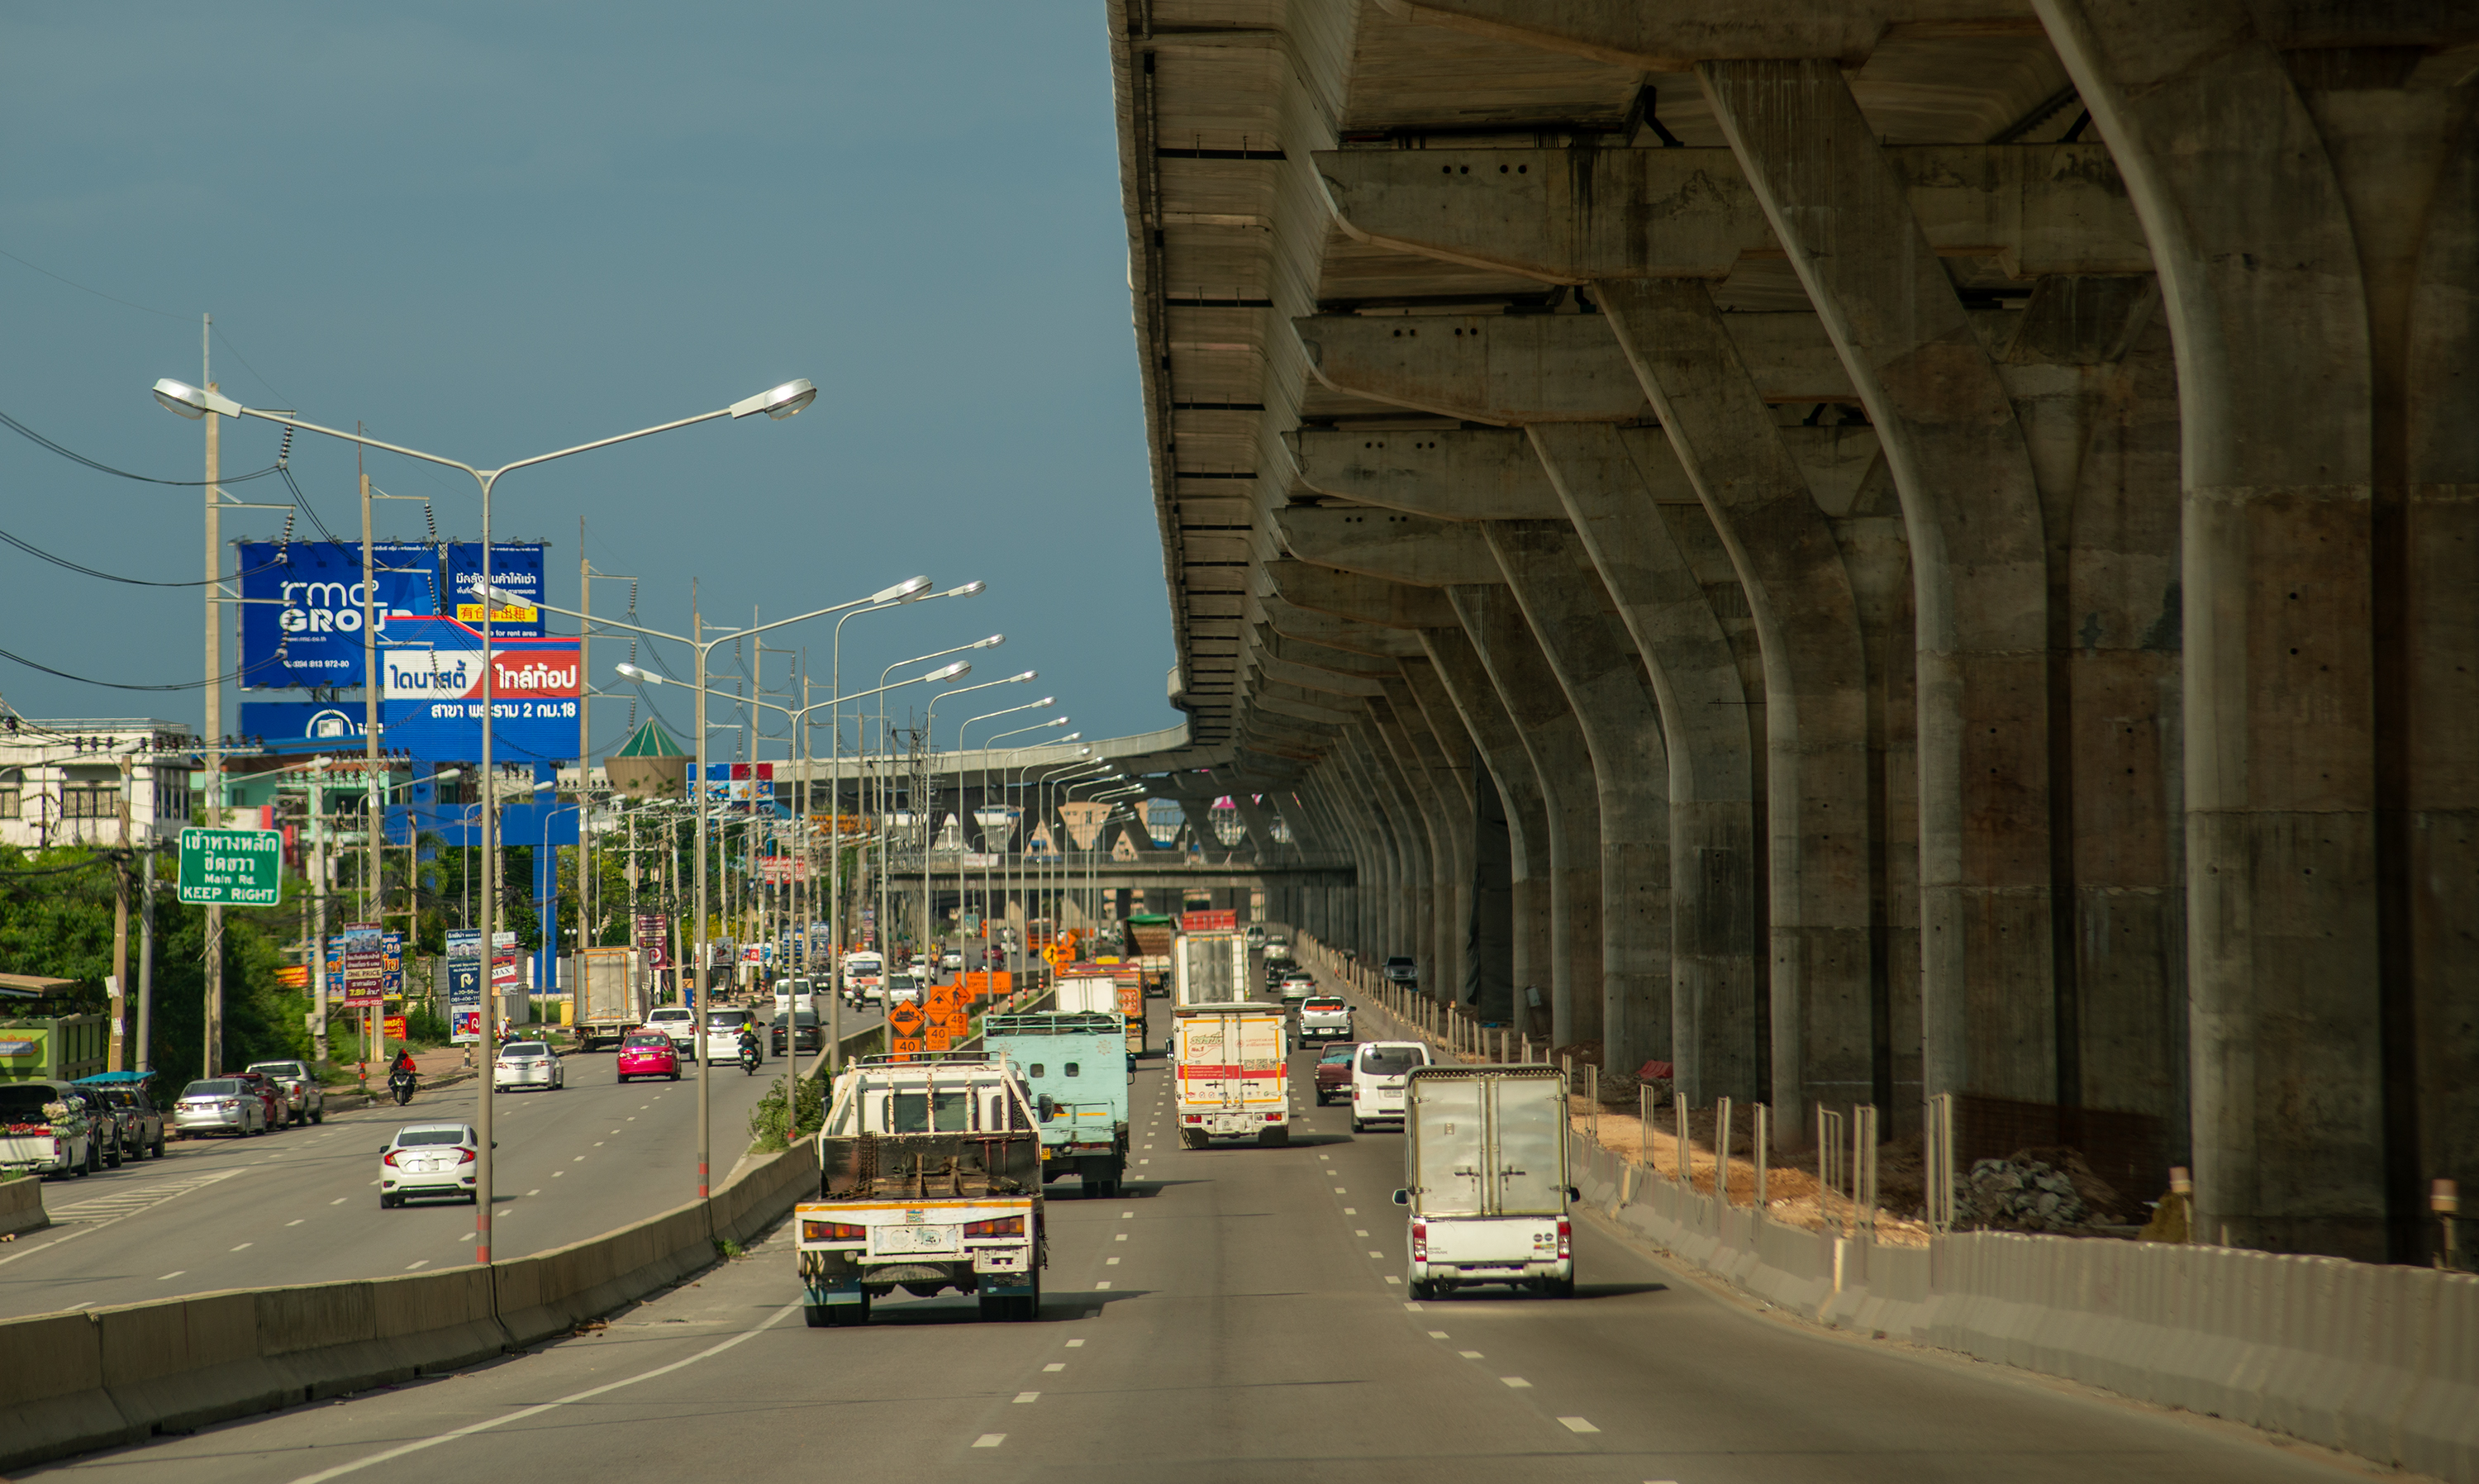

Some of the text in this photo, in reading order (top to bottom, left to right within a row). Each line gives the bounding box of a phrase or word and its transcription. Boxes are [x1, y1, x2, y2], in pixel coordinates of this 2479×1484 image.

[389, 659, 466, 689] ไดนาสตี้
[431, 703, 464, 718] สาขา
[523, 704, 533, 717] 2
[537, 702, 576, 718] กม.18
[185, 830, 277, 852] เข้าทางหลัก
[204, 849, 255, 873] ชิดขวา
[204, 873, 232, 885] Main
[183, 886, 275, 901] KEEP RIGHT
[951, 1015, 963, 1024] 40
[931, 1030, 945, 1039] 40
[899, 1041, 916, 1051] 40
